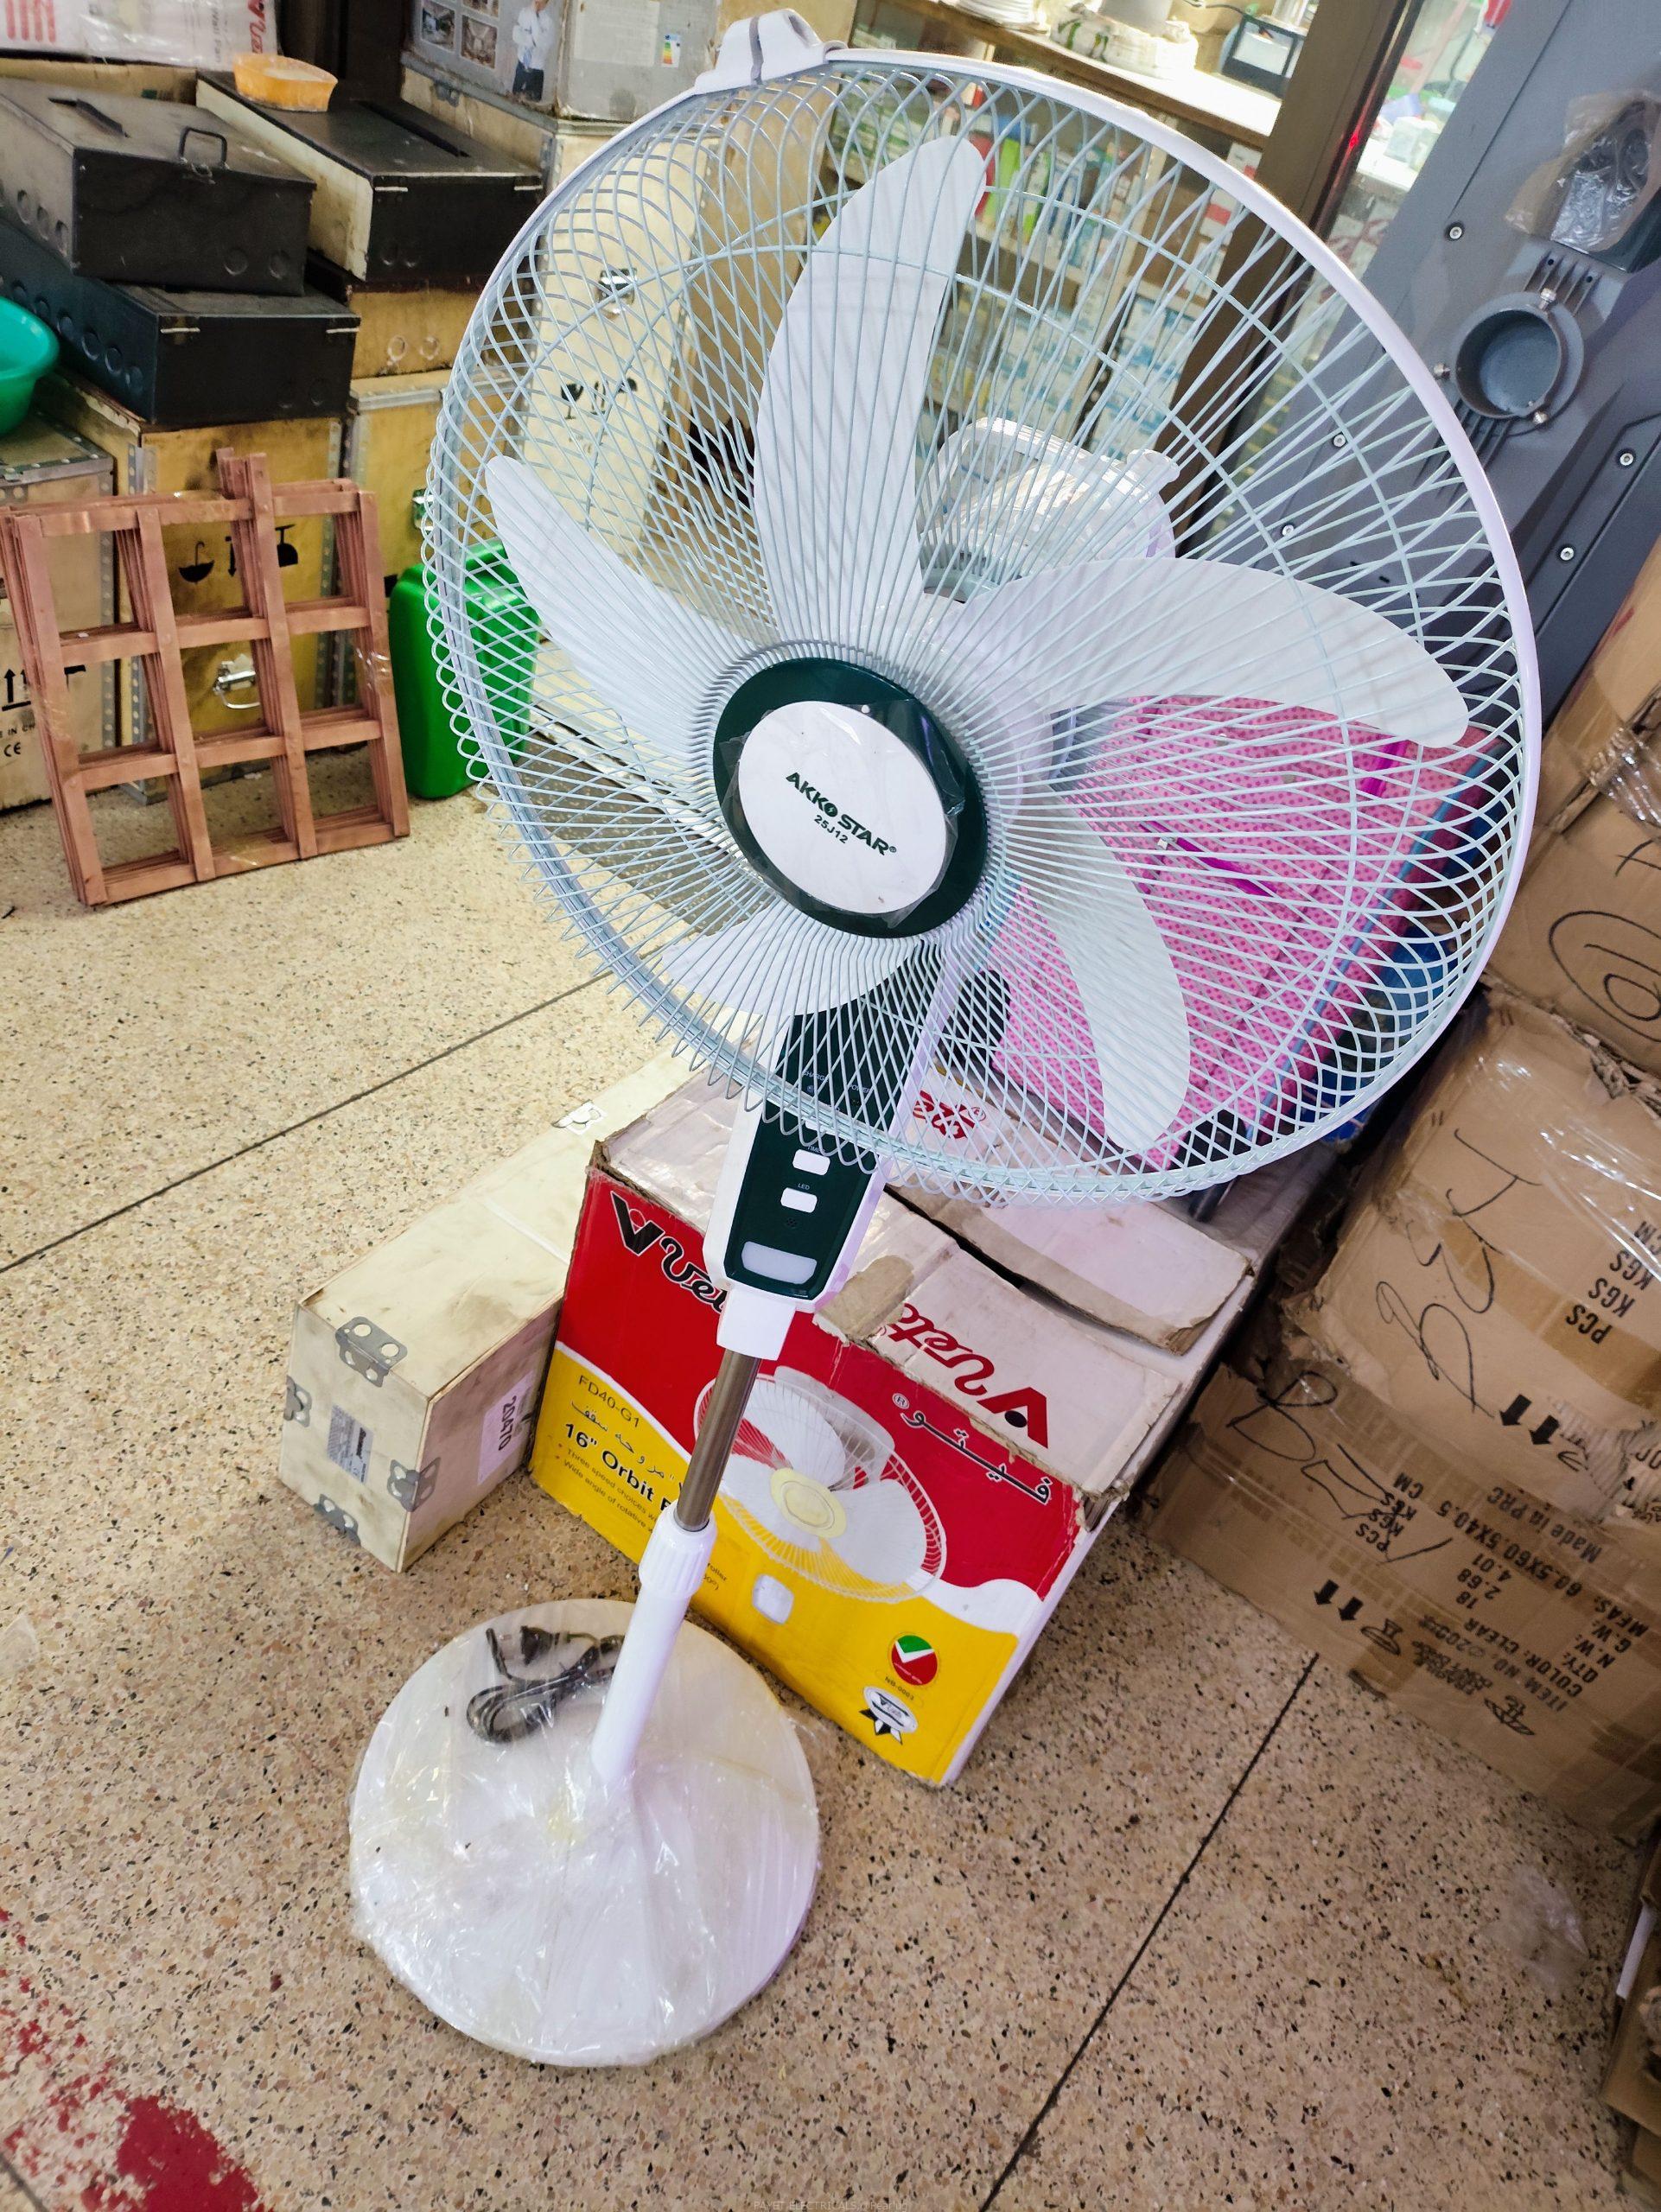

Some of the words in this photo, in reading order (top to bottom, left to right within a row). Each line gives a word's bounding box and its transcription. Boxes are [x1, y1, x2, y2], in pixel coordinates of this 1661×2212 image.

[785, 772, 838, 818] AKKO
[813, 814, 849, 844] 25J12
[798, 1182, 811, 1191] LED
[1609, 1249, 1654, 1290] KGS
[1588, 1277, 1635, 1318] KGS
[1565, 1304, 1613, 1344] PCS
[578, 1375, 640, 1428] FD40-G1
[565, 1423, 598, 1449] 16"
[601, 1450, 654, 1502] Orbit
[567, 1448, 589, 1470] Three
[591, 1466, 616, 1490] speed
[616, 1487, 646, 1514] choices
[563, 1459, 583, 1479] Wide
[584, 1477, 606, 1499] angle
[607, 1495, 617, 1505] of
[616, 1503, 646, 1529] rotative
[1392, 1471, 1424, 1499] CM
[1486, 1486, 1529, 1521] PRC
[1355, 1522, 1391, 1553] PCS
[1550, 1523, 1602, 1564] Made
[1457, 1567, 1501, 1599] 2.68
[1472, 1553, 1511, 1582] 4.01
[1455, 1590, 1478, 1610] 18
[1463, 1618, 1520, 1655] CLEAR
[1523, 1649, 1583, 1698] COLOR:
[1562, 1651, 1599, 1684] QTY:
[1524, 1675, 1569, 1713] ITEM
